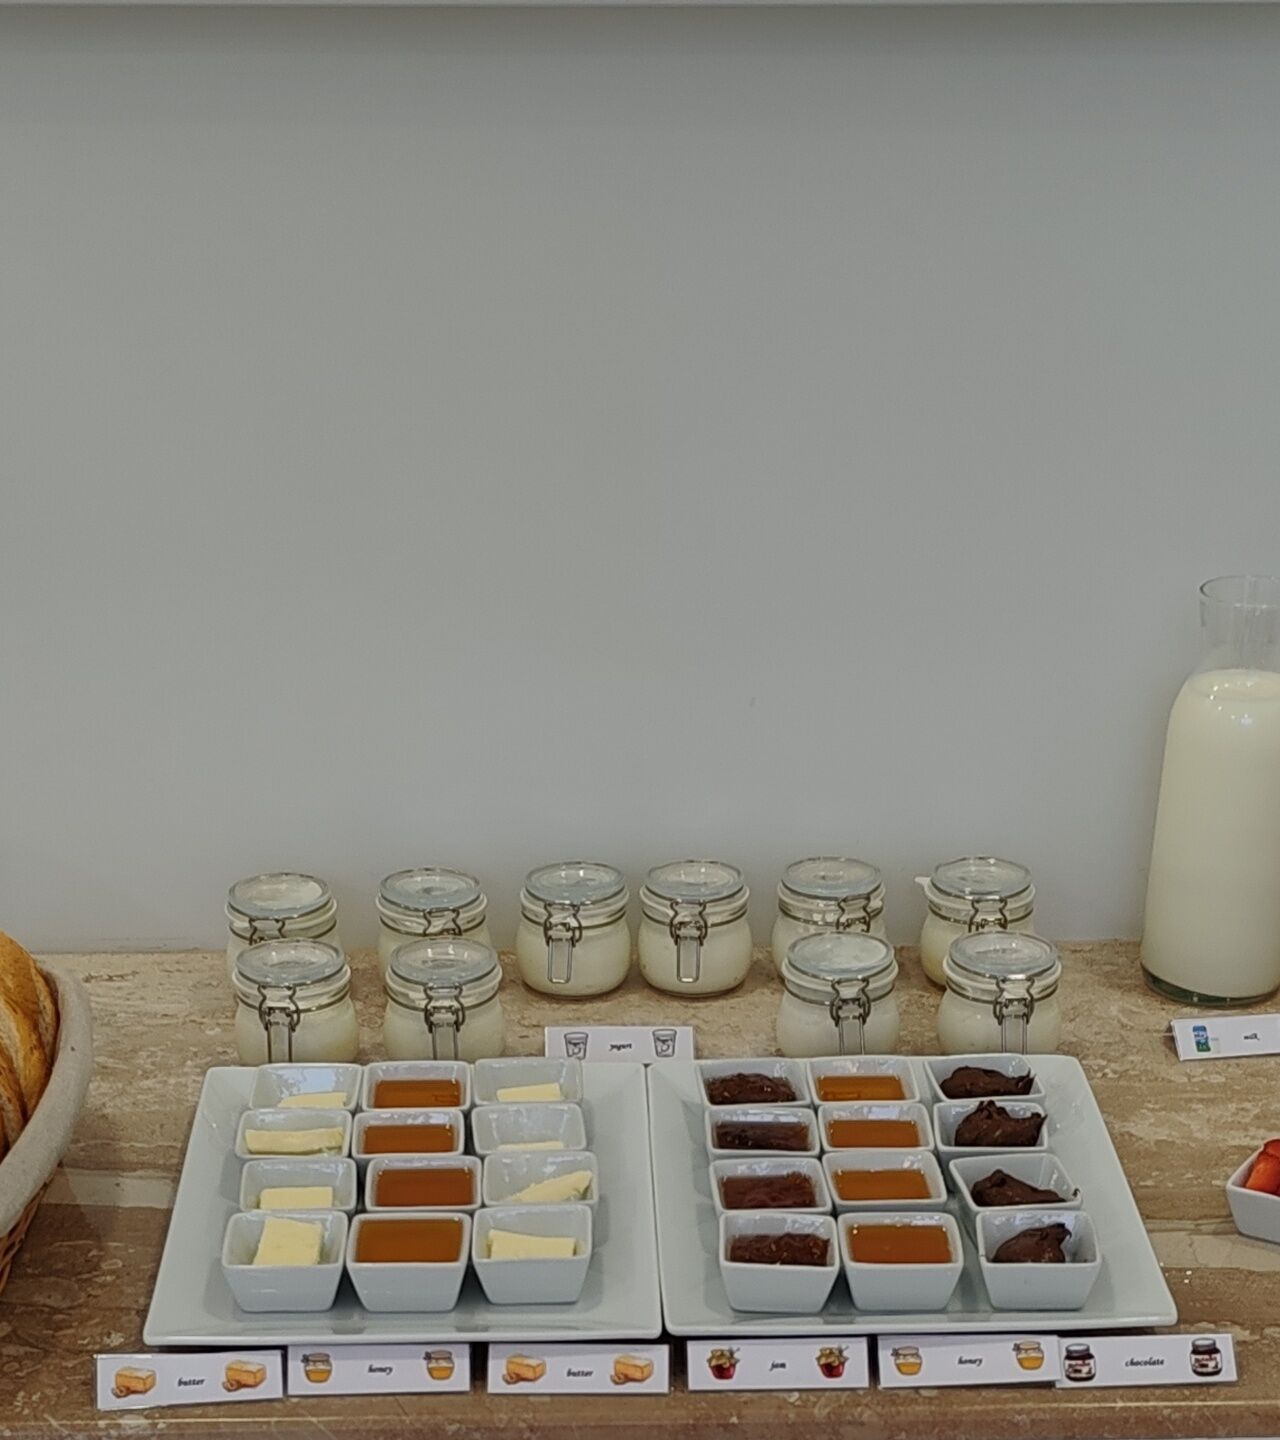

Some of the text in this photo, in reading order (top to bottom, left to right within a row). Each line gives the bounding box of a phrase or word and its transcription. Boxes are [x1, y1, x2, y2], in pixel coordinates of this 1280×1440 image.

[769, 1361, 787, 1372] jam
[957, 1356, 984, 1367] honey
[1124, 1356, 1164, 1367] chocolate
[367, 1364, 393, 1376] honey
[566, 1368, 594, 1378] butter
[177, 1377, 205, 1387] butter
